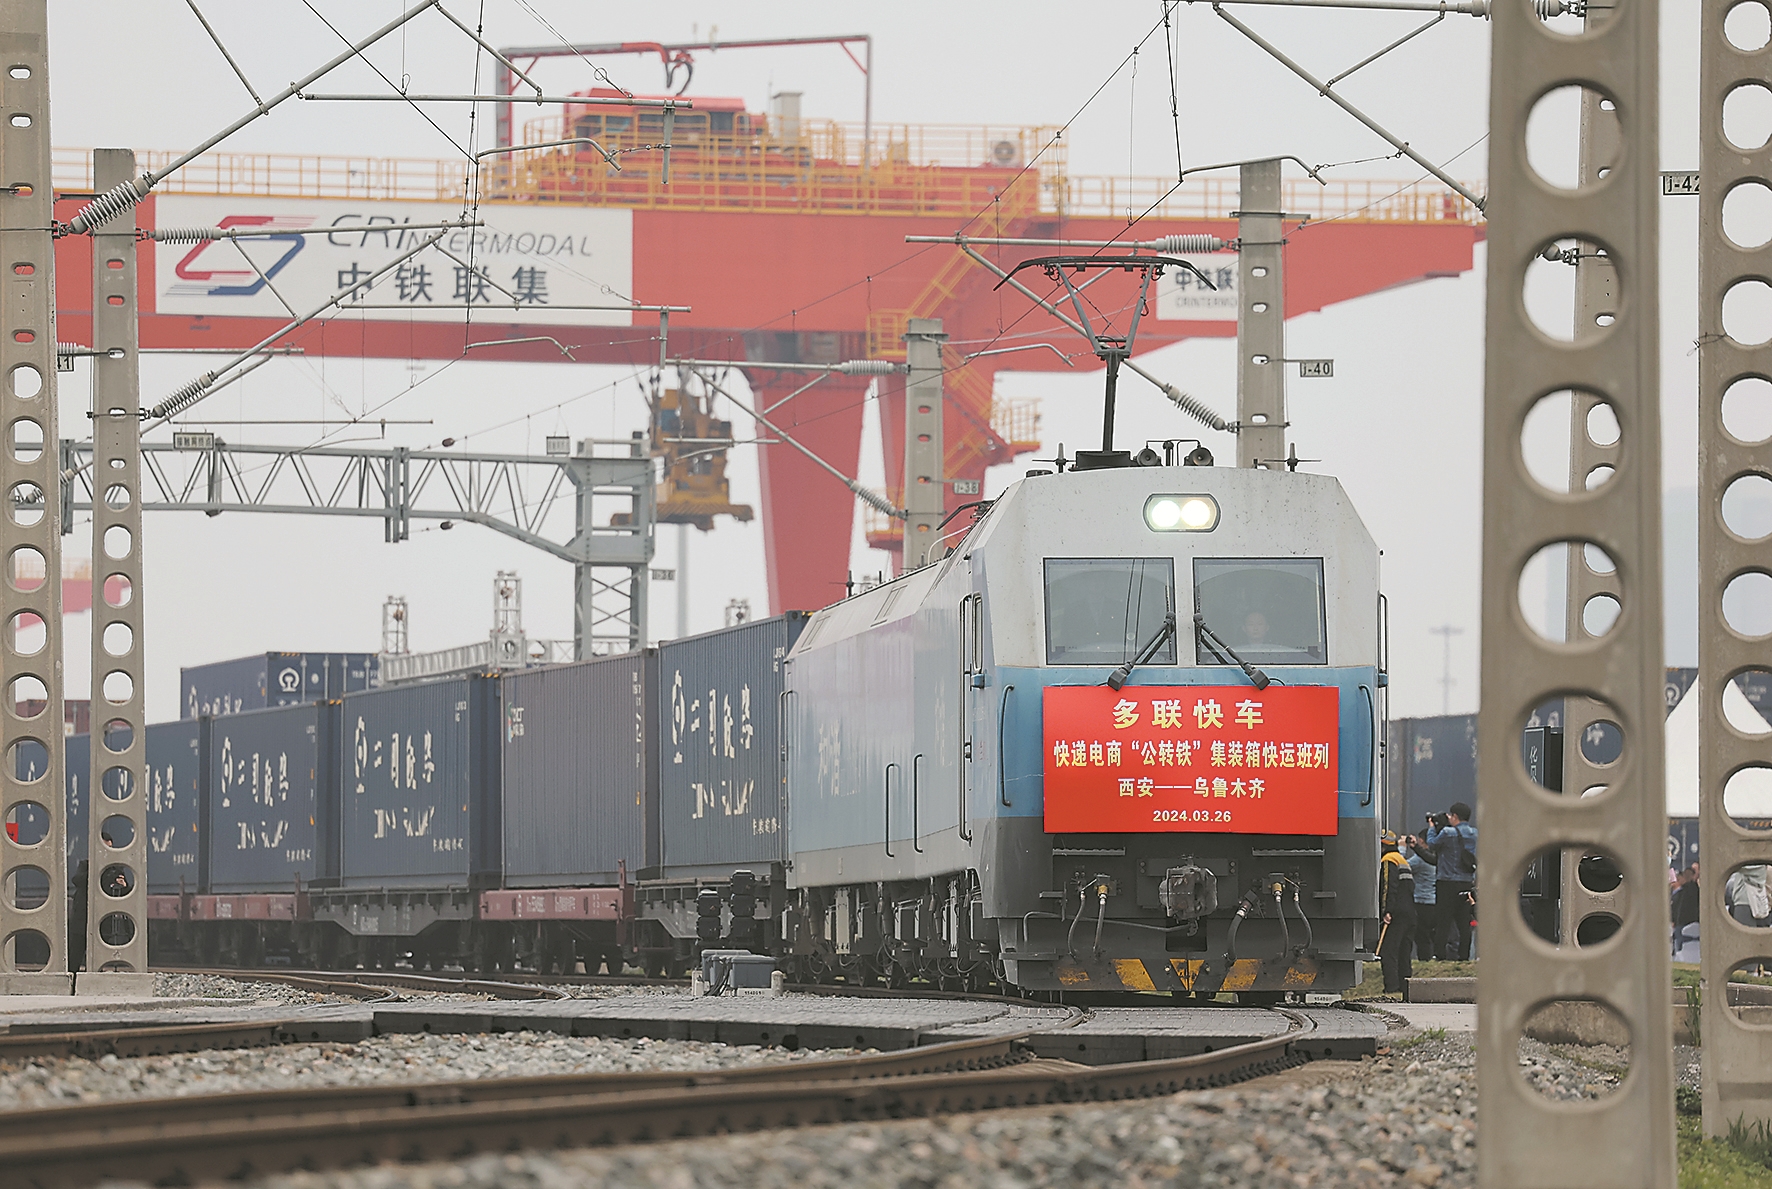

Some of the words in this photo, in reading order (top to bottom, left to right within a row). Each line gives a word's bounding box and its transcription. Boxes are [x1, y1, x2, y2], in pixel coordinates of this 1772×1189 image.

[337, 262, 549, 304] 中铁联集
[1302, 362, 1330, 376] j-40
[1112, 698, 1264, 730] 多联快车
[1152, 809, 1232, 822] 2024.03.26
